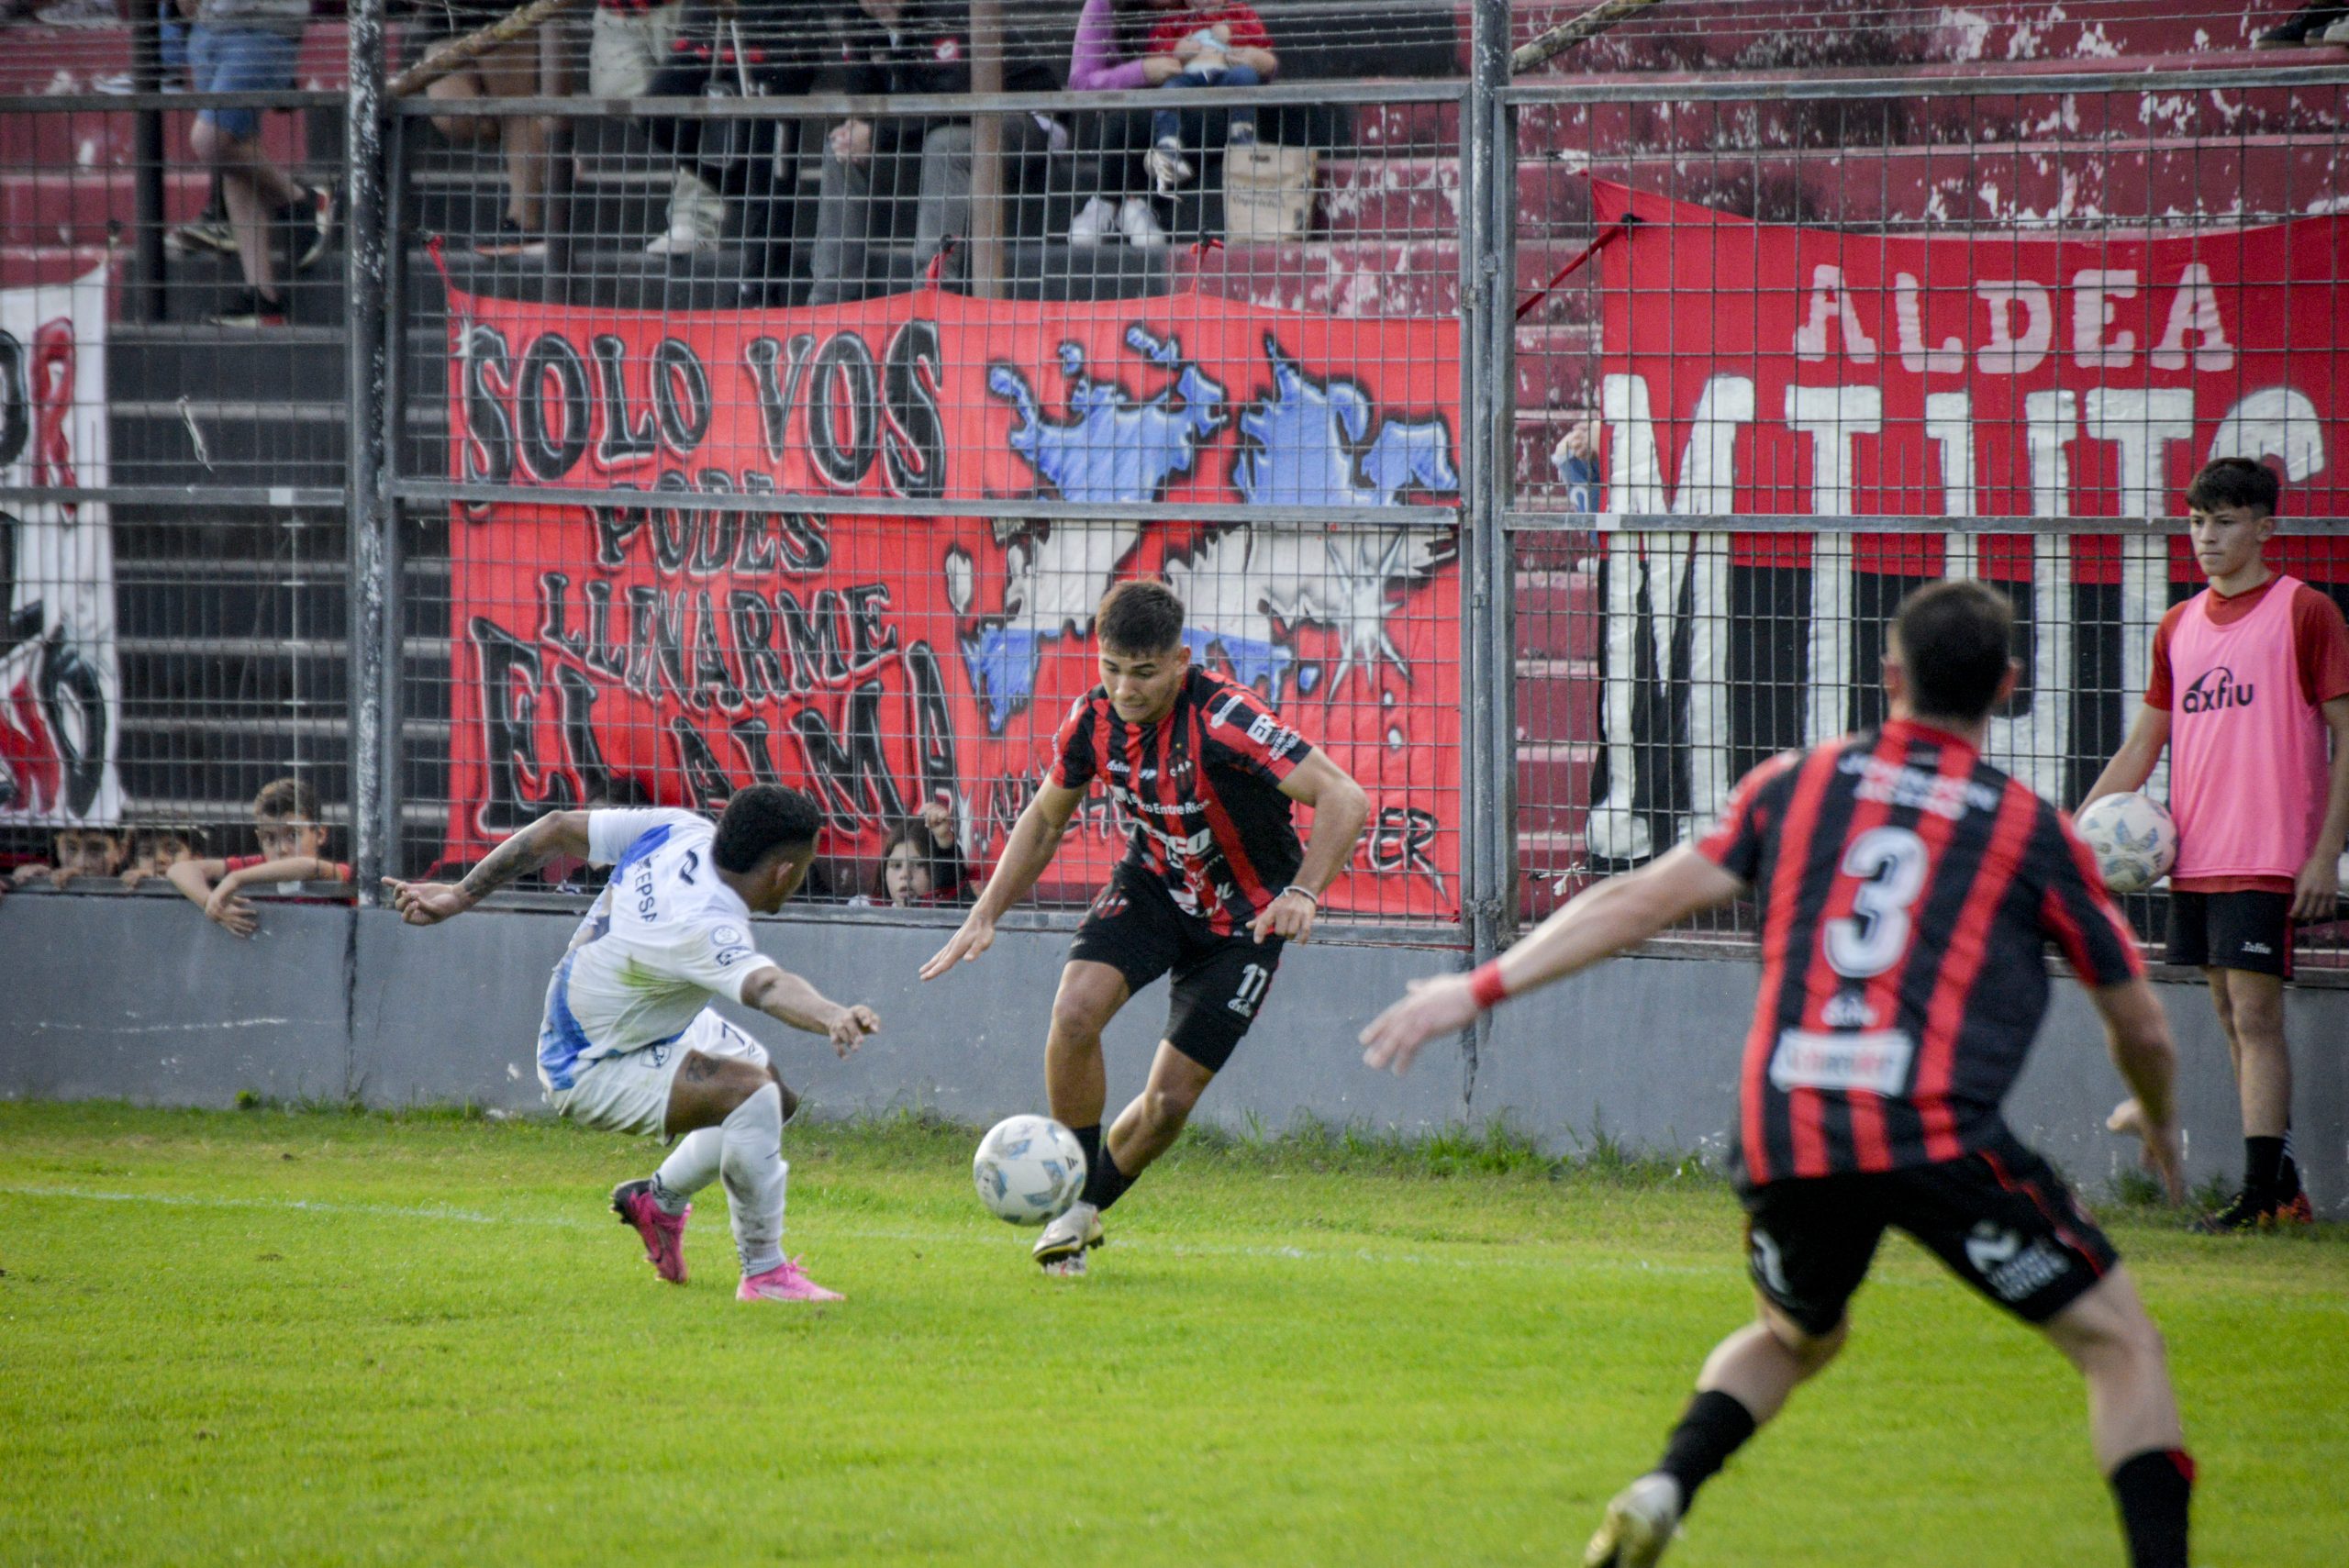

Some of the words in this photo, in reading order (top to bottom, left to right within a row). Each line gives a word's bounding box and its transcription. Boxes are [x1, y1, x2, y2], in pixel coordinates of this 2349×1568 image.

[1794, 263, 2234, 374] ALDEA
[462, 321, 713, 512] SOLO
[744, 317, 948, 505] VOS
[590, 469, 829, 576] PODES
[539, 572, 899, 717] LLENARME
[2183, 667, 2254, 714] axfiu
[1822, 825, 1927, 979] 3
[1235, 963, 1268, 1004] 11
